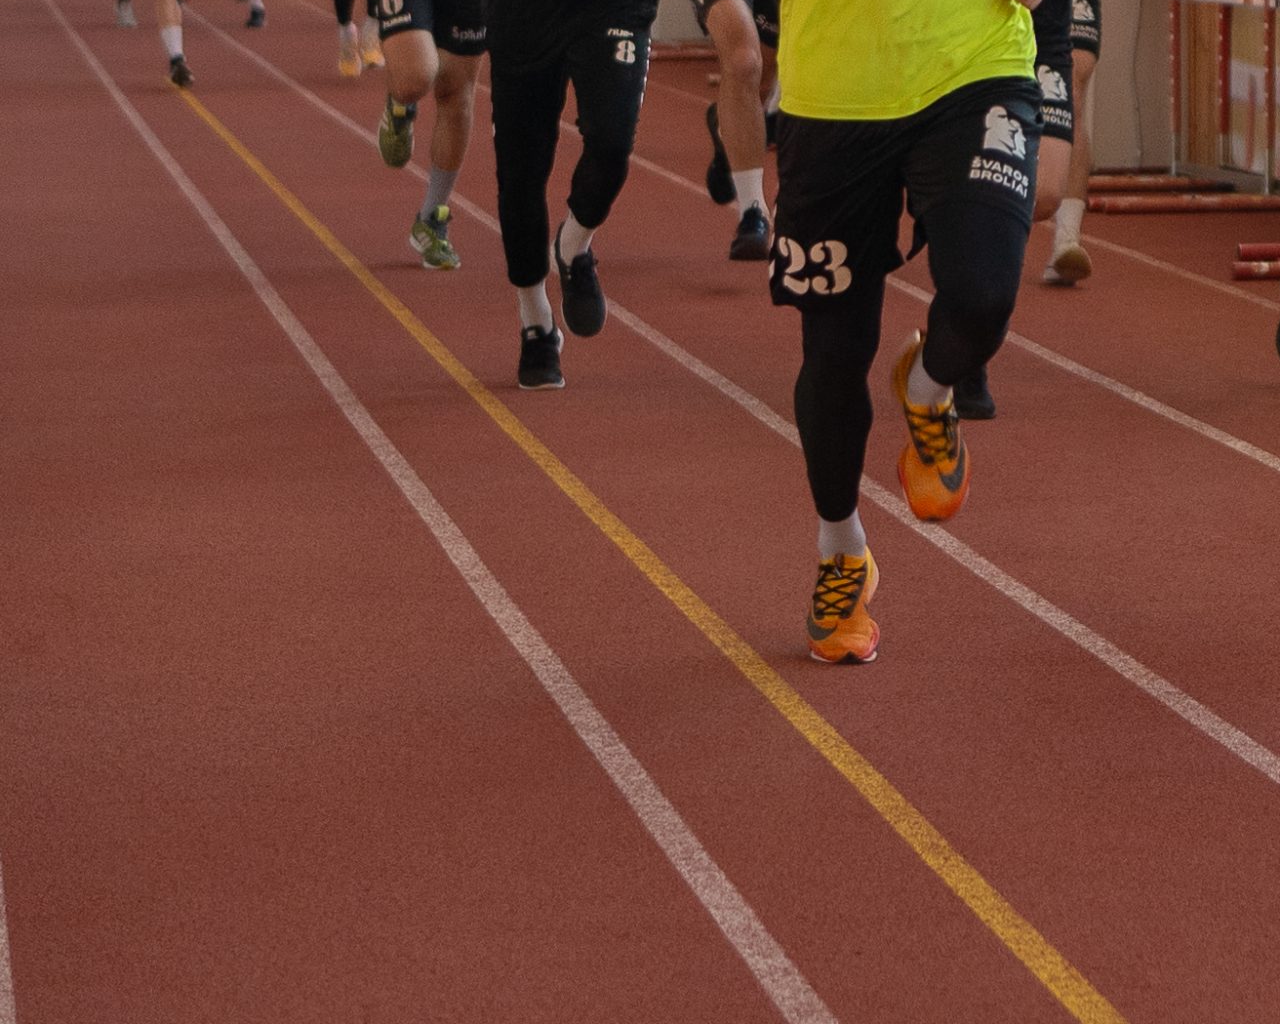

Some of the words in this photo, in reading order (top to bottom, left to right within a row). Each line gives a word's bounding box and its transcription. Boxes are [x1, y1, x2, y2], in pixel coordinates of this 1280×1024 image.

[615, 40, 636, 64] 8
[969, 168, 1028, 199] BROLIAI
[970, 155, 1029, 187] ŠVAROS
[778, 236, 852, 295] 23
